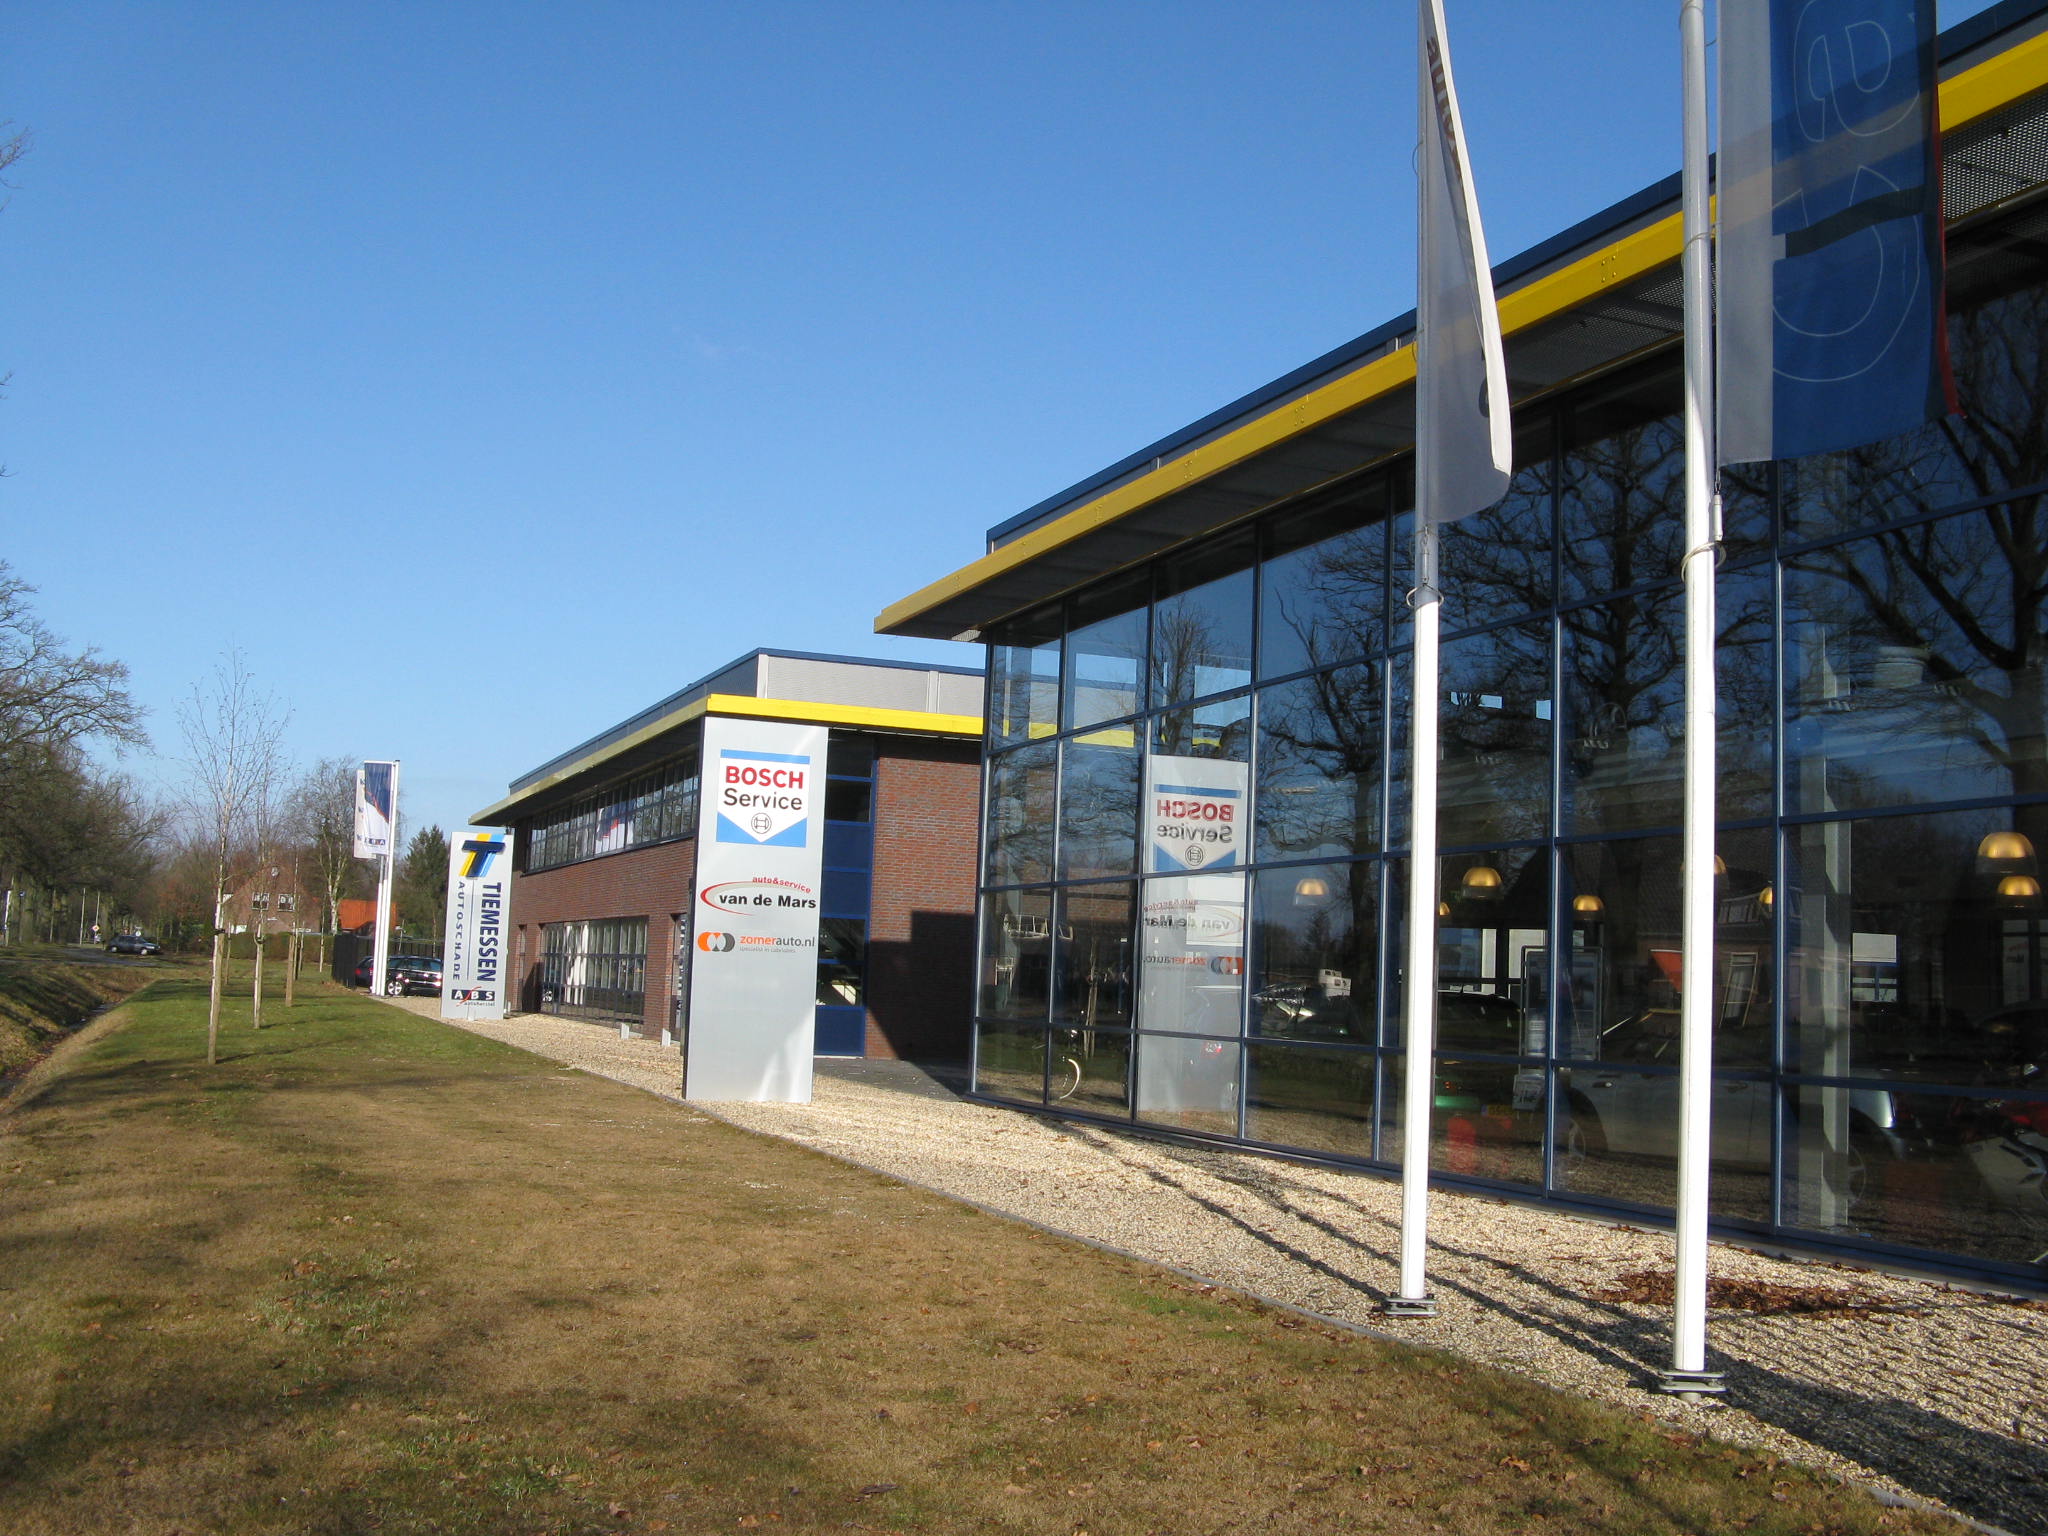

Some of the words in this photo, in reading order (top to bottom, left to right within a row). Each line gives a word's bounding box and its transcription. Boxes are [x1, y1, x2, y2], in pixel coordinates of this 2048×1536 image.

[725, 765, 804, 789] BOSCH
[723, 787, 803, 811] Service
[752, 876, 811, 893] auto&service
[719, 893, 747, 905] van
[753, 892, 772, 906] de
[777, 895, 817, 909] Mars
[453, 881, 466, 981] AUTOSCHADE
[477, 882, 502, 982] TIEMESSEN
[739, 934, 815, 948] zomerauto.nl
[454, 990, 494, 1000] ABS
